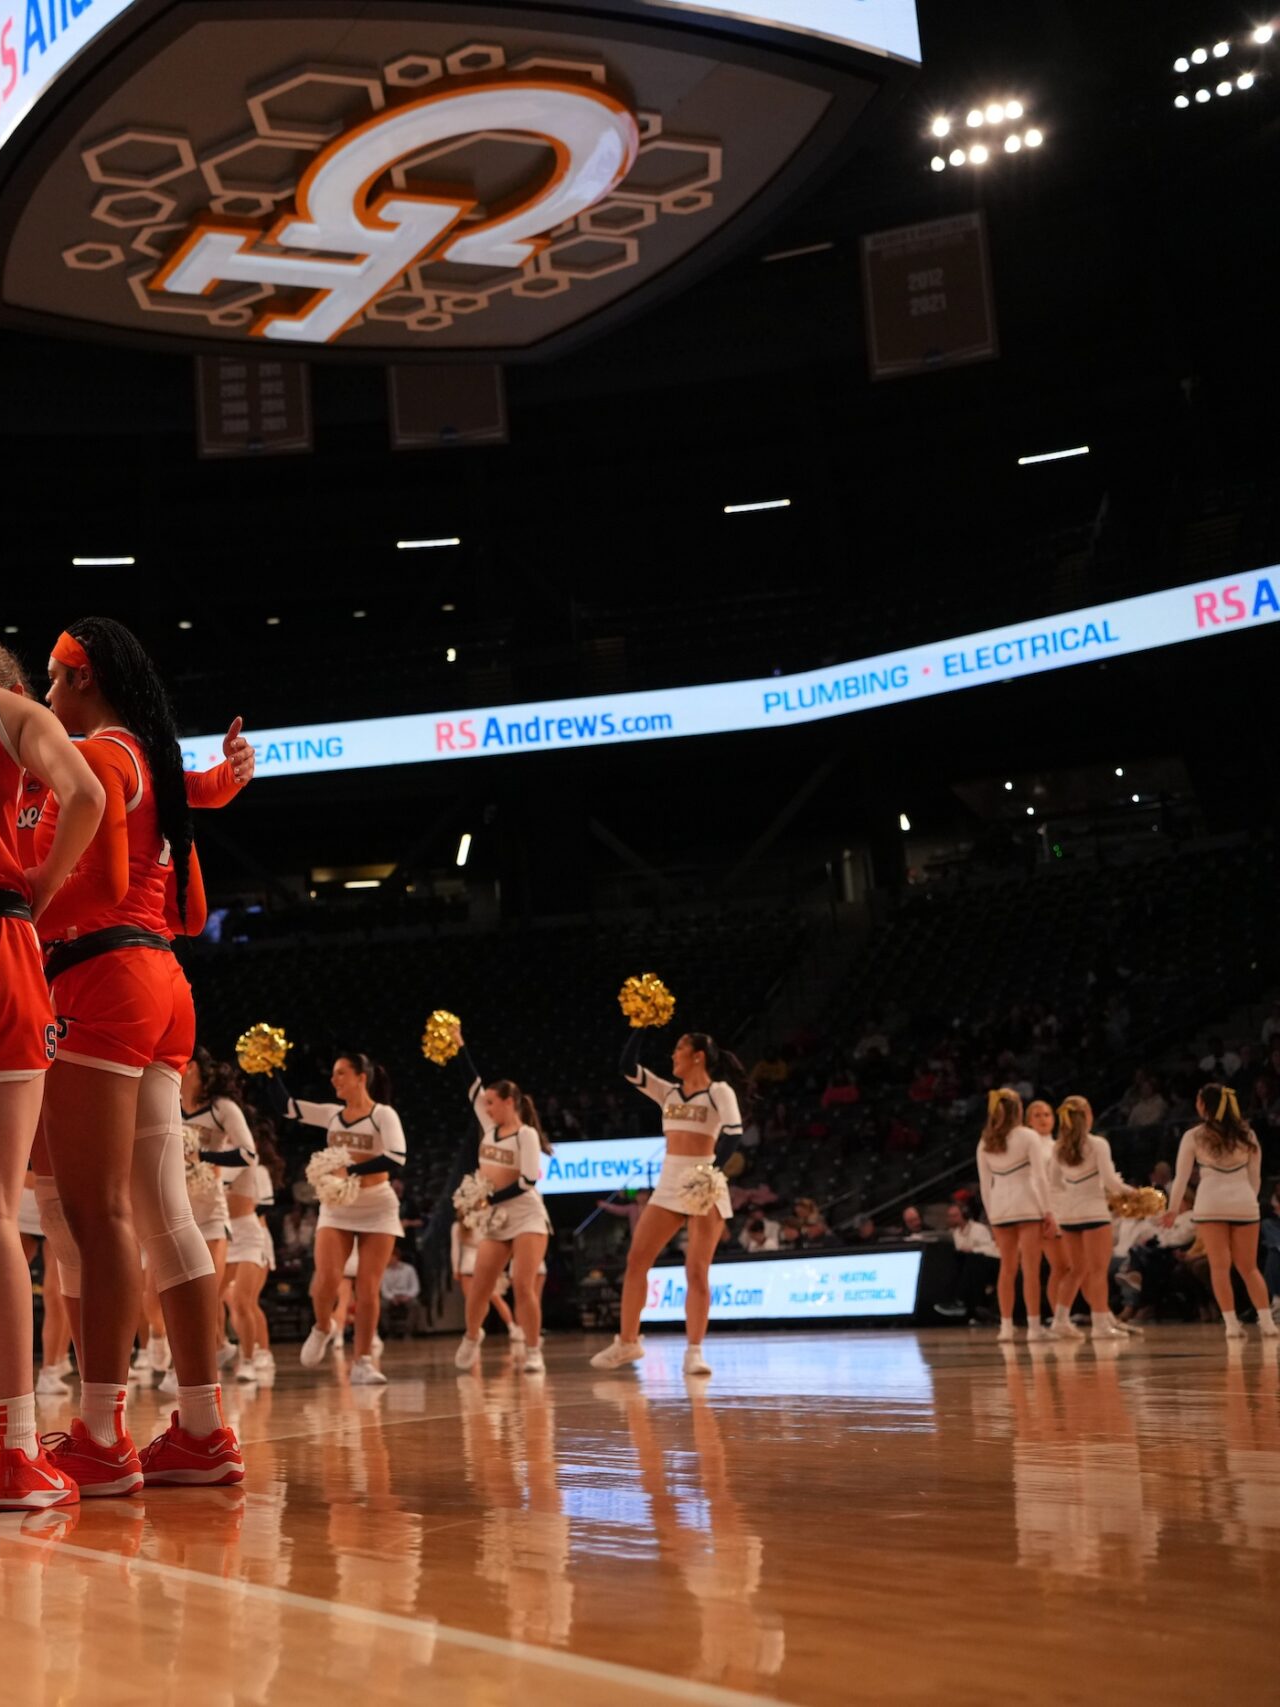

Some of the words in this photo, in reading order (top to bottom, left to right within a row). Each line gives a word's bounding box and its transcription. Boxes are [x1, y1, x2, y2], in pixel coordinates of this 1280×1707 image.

[762, 665, 909, 714] PLUMBING
[944, 619, 1121, 678] ELECTRICAL
[44, 1023, 58, 1062] S
